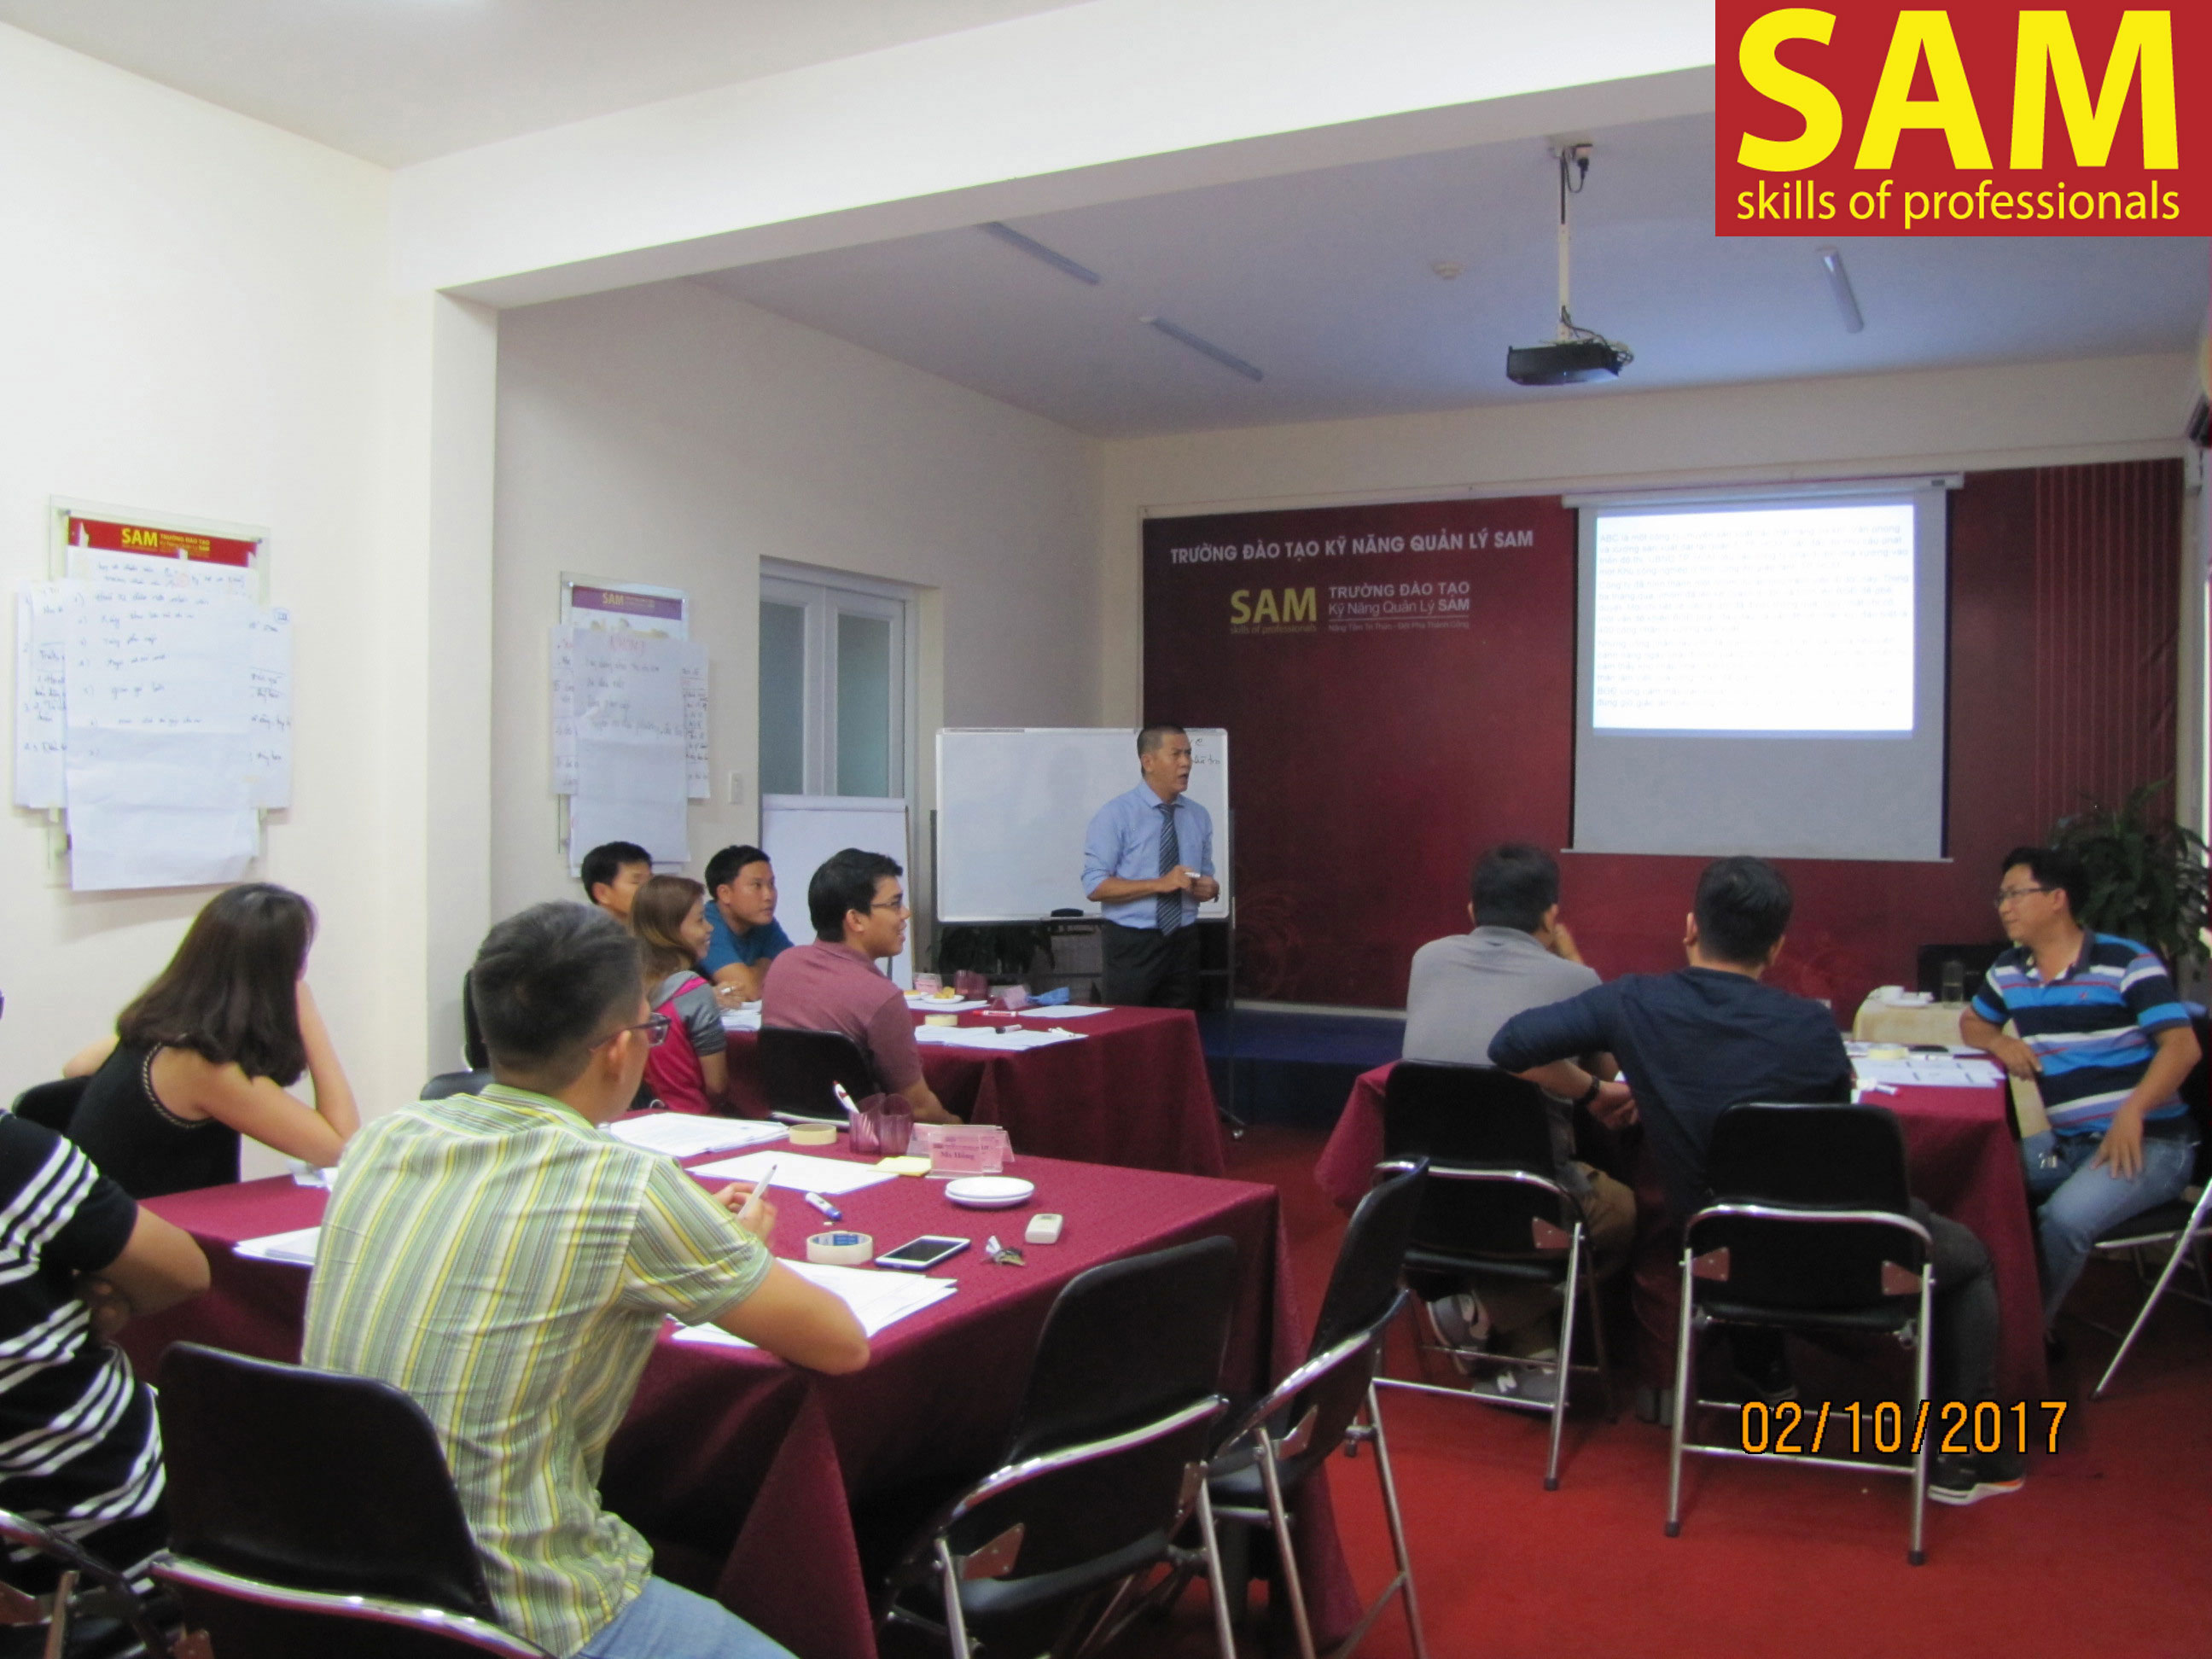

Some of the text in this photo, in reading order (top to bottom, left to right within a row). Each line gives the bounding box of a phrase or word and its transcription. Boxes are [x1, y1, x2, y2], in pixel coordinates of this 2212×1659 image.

[122, 527, 158, 547] SAM
[1171, 527, 1534, 564] TRƯỜNG ĐÀO TẠO KỸ NĂNG QUẢN LÝ SAM
[602, 592, 624, 606] SAM
[1329, 580, 1470, 599] TRƯỜNG ĐÀO TẠO
[1230, 587, 1318, 624] SAM
[1329, 598, 1470, 616] Kỹ Năng Quản Lý SAM
